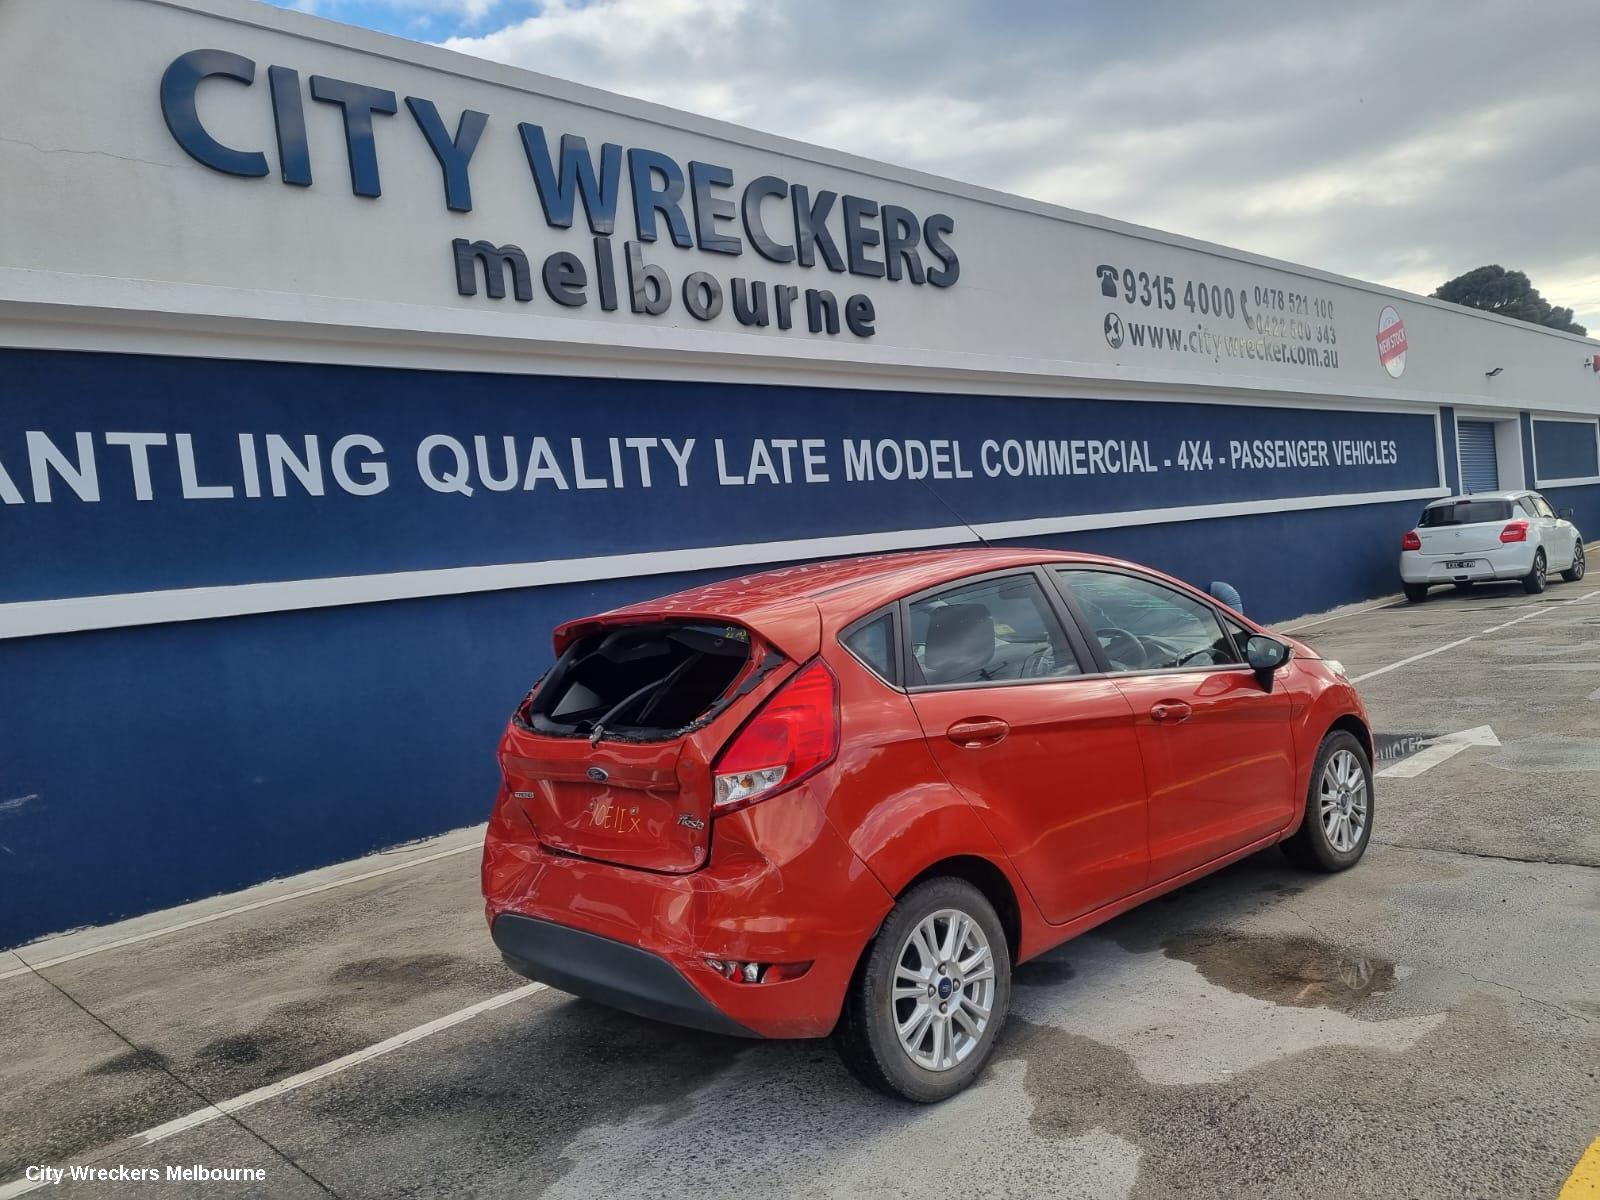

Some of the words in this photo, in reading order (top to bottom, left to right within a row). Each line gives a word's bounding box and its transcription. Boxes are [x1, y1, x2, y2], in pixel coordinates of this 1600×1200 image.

[160, 48, 489, 212] CITY
[517, 121, 960, 289] WRECKERS
[452, 236, 877, 337] melbourne
[1122, 268, 1176, 310] 9315
[1184, 280, 1235, 319] 4000
[1254, 286, 1285, 311] 0478
[1289, 292, 1309, 315] 521
[1316, 324, 1336, 344] 343
[416, 434, 696, 497] QUALITY
[714, 438, 830, 485] LATE
[843, 439, 973, 481] MODEL
[981, 439, 1158, 478] COMMERCIAL
[1177, 440, 1213, 471] 4X4
[1230, 440, 1330, 470] PASSENGER
[1332, 440, 1397, 466] VEHICLES
